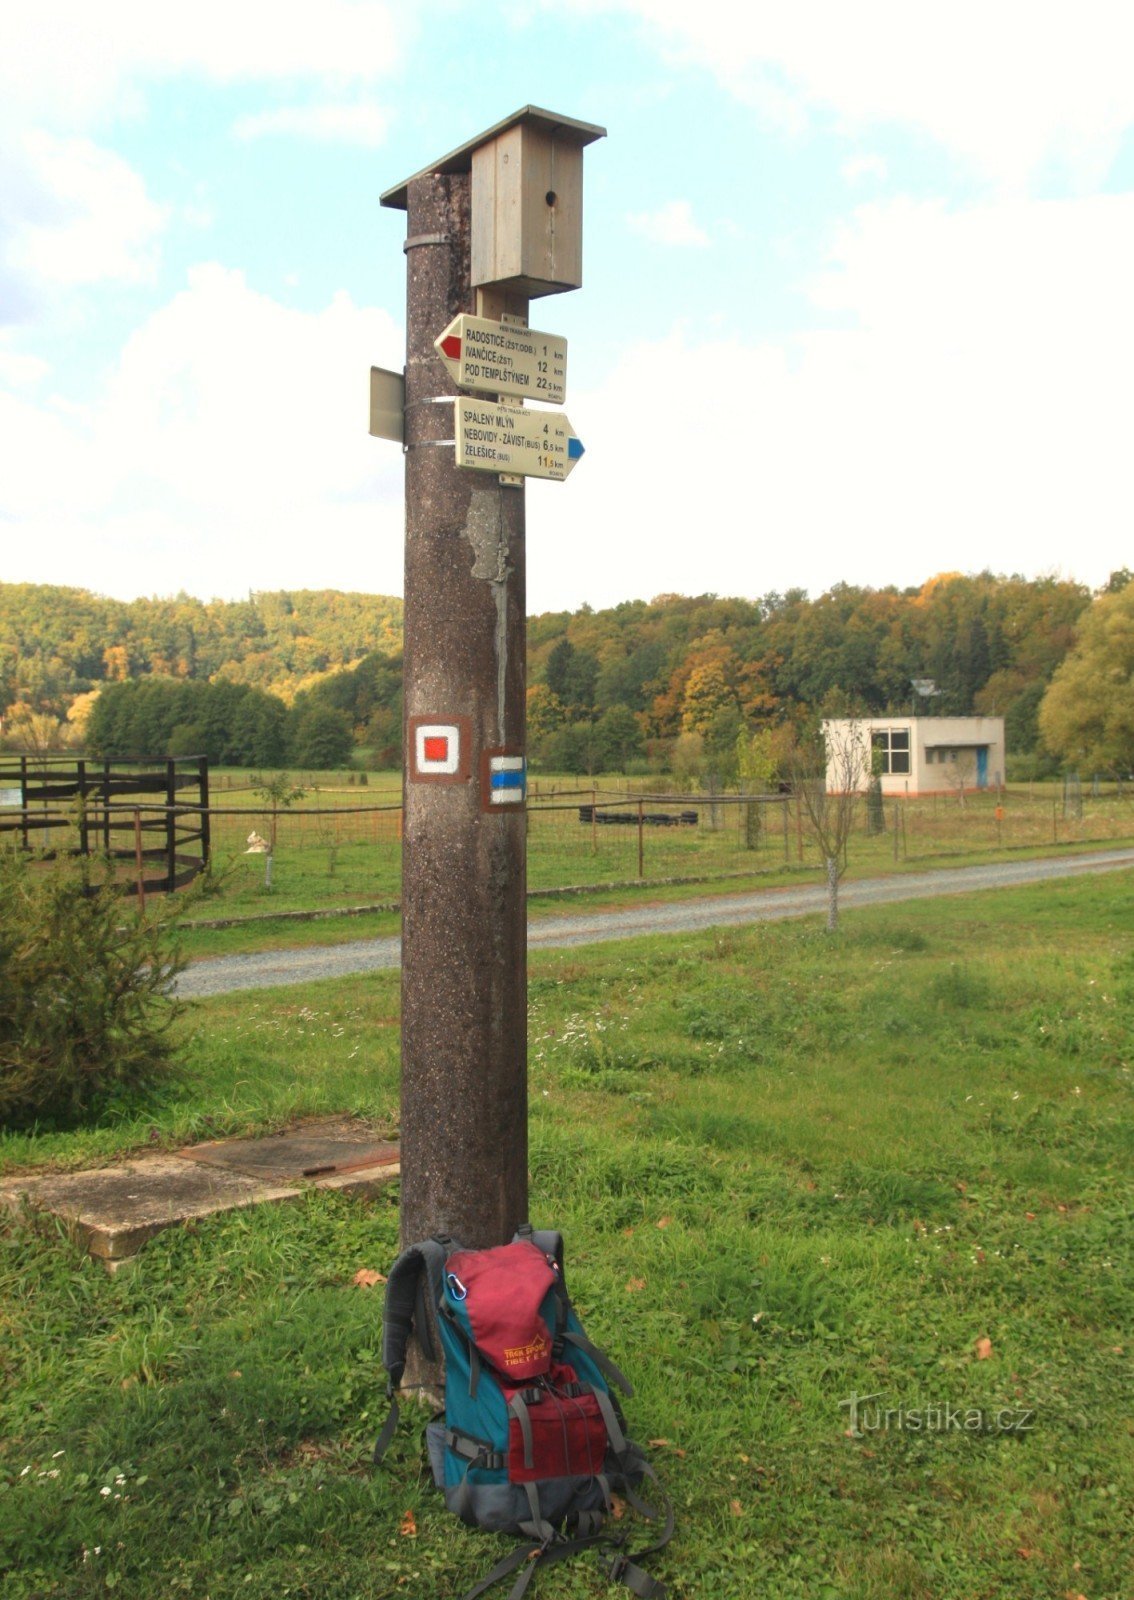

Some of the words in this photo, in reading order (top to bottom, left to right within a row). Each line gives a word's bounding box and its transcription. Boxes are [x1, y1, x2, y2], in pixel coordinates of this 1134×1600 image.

[466, 329, 504, 347] RADOSTICE
[543, 345, 547, 356] 1
[554, 352, 563, 360] km
[466, 347, 496, 363] IVANČICE
[538, 361, 547, 372] 12
[554, 368, 563, 376] km
[465, 363, 479, 376] POD
[553, 383, 562, 392] km
[495, 415, 514, 429] MLÝN
[543, 424, 548, 434] 4
[555, 429, 564, 437] km
[464, 428, 498, 444] NEBOVIDY
[503, 432, 525, 447] ZÁVIST
[525, 440, 540, 451] (BUS)
[555, 443, 564, 452] km
[465, 442, 496, 459] ŽELEŠICE
